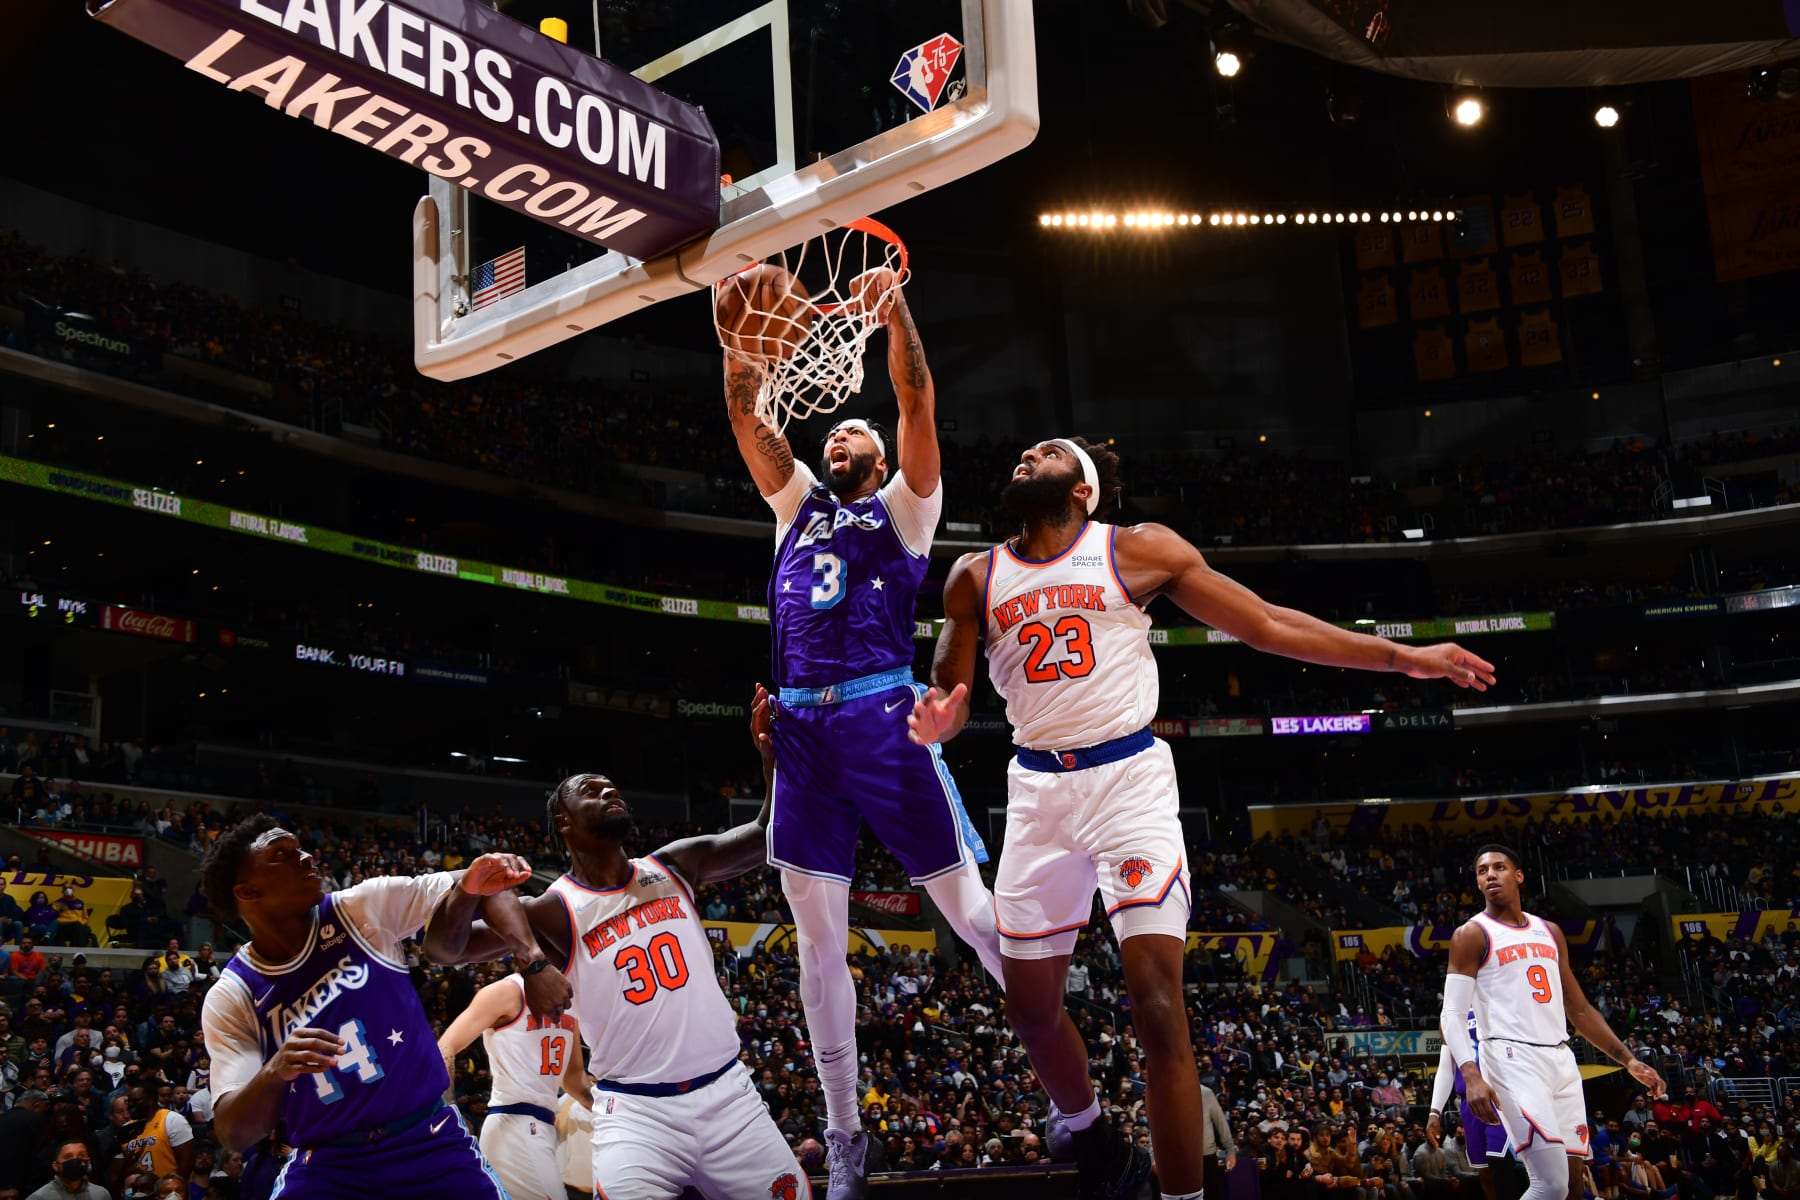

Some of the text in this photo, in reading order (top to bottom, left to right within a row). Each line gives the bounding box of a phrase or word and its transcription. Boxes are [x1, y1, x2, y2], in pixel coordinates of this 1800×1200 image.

[931, 45, 947, 70] 75
[184, 28, 647, 240] LAKERS.COM
[55, 321, 131, 354] Spectrum
[132, 488, 182, 516] SELTZER
[229, 510, 269, 535] NATURAL
[416, 553, 458, 575] SELTZER
[811, 552, 848, 610] 3
[661, 596, 699, 616] SELTZER
[992, 583, 1107, 635] NEW YORK
[1644, 603, 1719, 616] AMERICAN EXPRESS
[1375, 623, 1414, 638] SELTZER
[1455, 620, 1490, 635] NATURAL
[1017, 614, 1097, 684] 23
[676, 698, 744, 717] Spectrum
[1150, 721, 1186, 735] HIBA
[1302, 715, 1365, 734] LAKERS
[1399, 714, 1449, 728] DELTA
[582, 896, 688, 960] NEW YORK
[320, 932, 347, 951] bibigo
[1496, 943, 1528, 967] NEW
[614, 931, 690, 1006] 30
[1527, 964, 1553, 1004] 9
[267, 954, 370, 1050] LAKERS
[540, 1035, 566, 1076] 13
